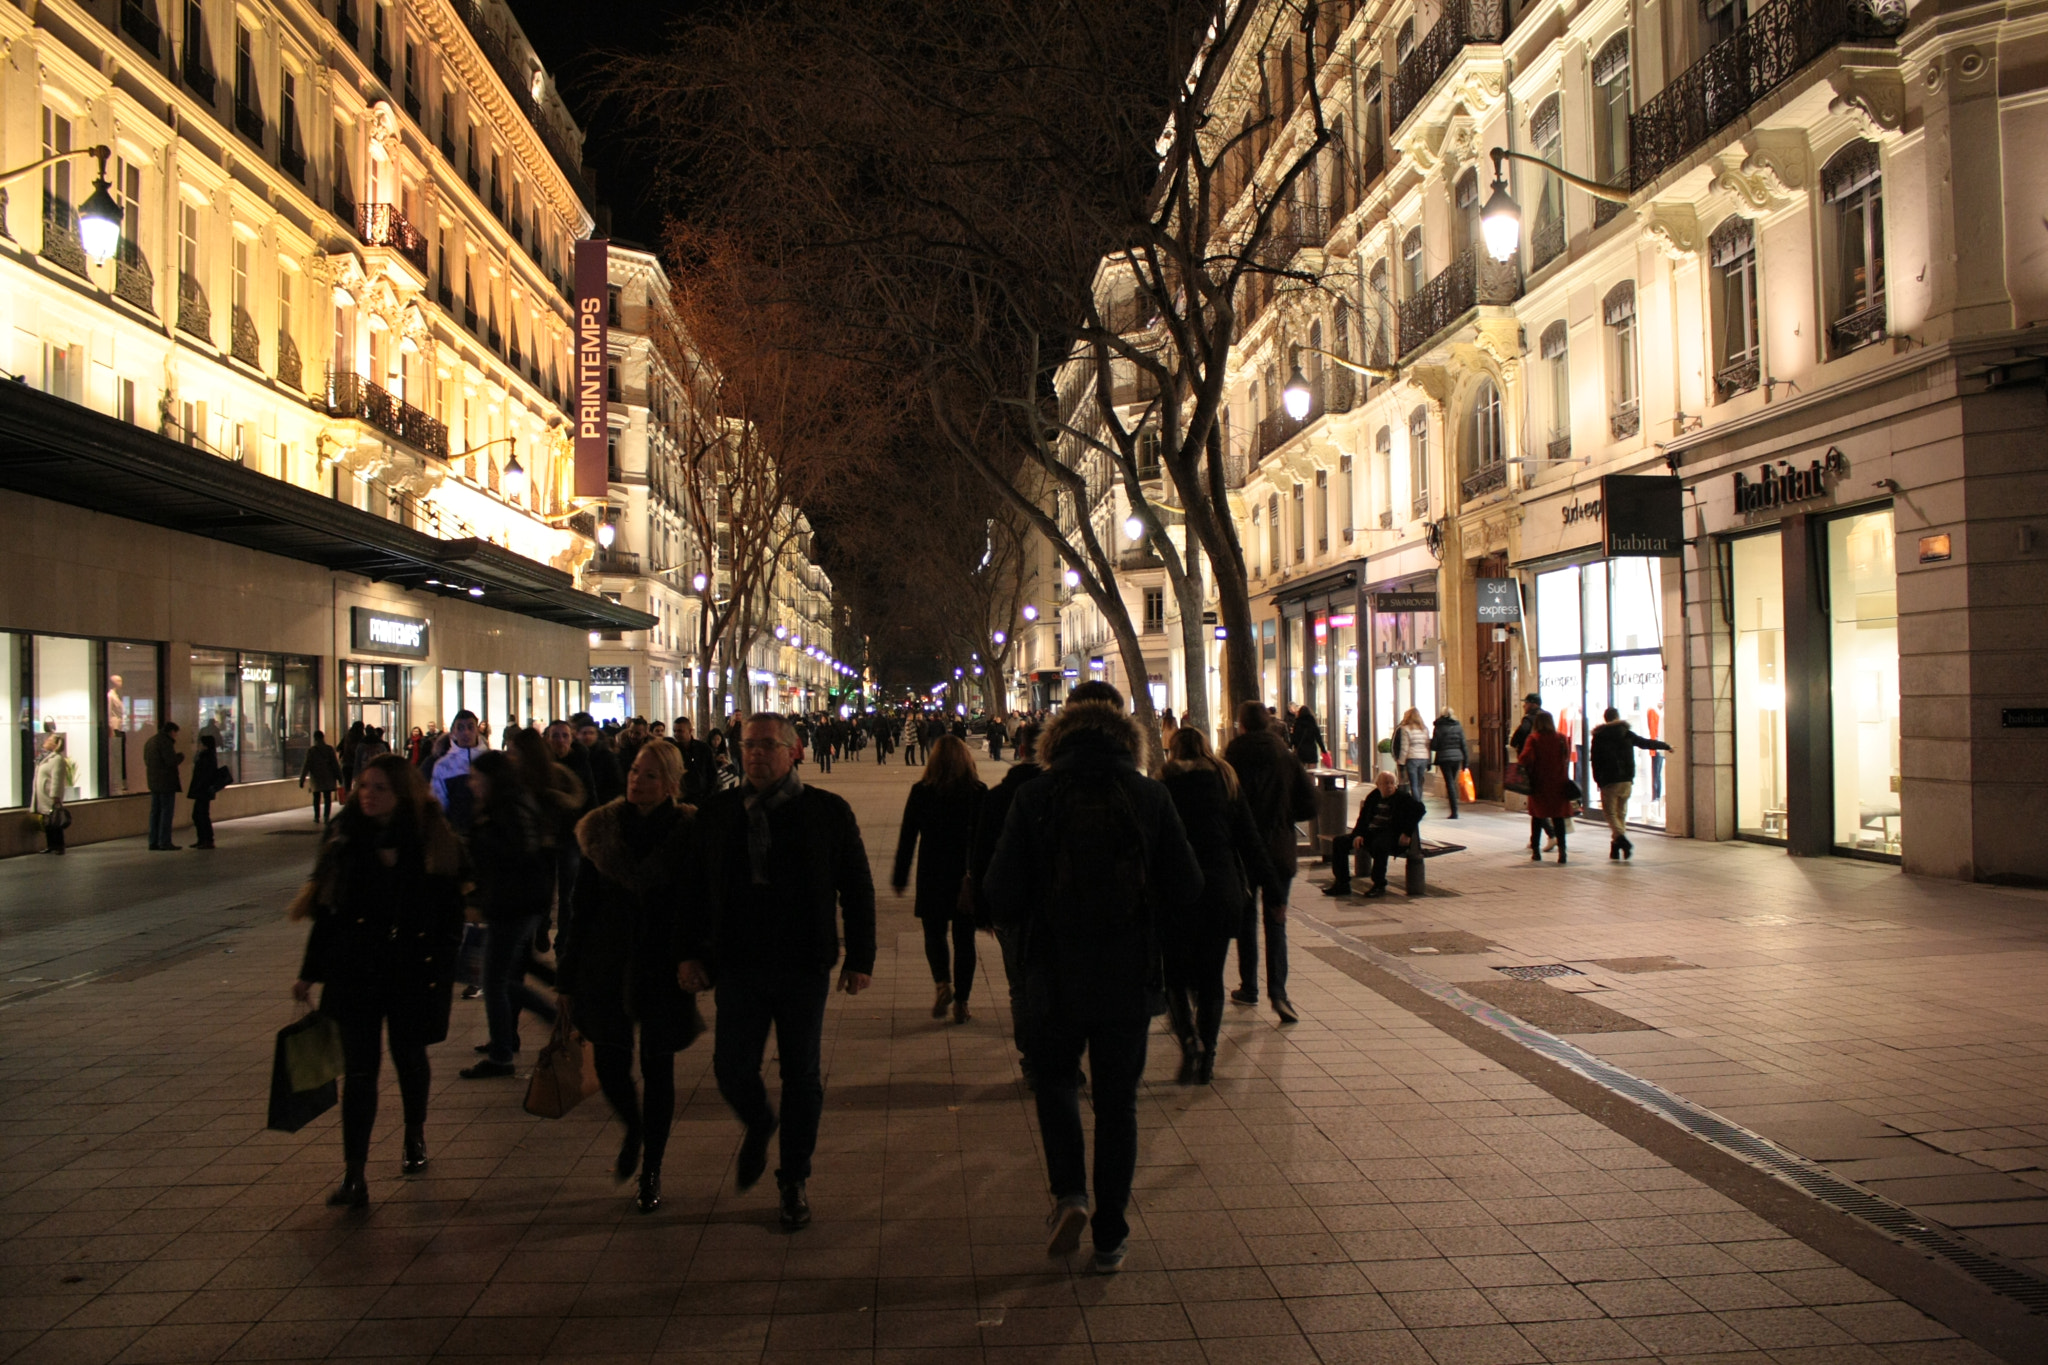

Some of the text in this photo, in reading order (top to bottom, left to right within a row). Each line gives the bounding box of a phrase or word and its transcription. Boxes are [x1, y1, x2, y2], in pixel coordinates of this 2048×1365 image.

[581, 297, 601, 439] PRINTEMPS
[1732, 459, 1826, 515] habitat
[1612, 533, 1668, 550] habitat
[1487, 581, 1507, 594] Sud
[1390, 598, 1434, 607] SWAROVSKI
[1479, 605, 1519, 618] express
[370, 618, 420, 647] PRINTEMPS
[242, 668, 272, 681] GUCCI
[1633, 671, 1663, 689] express
